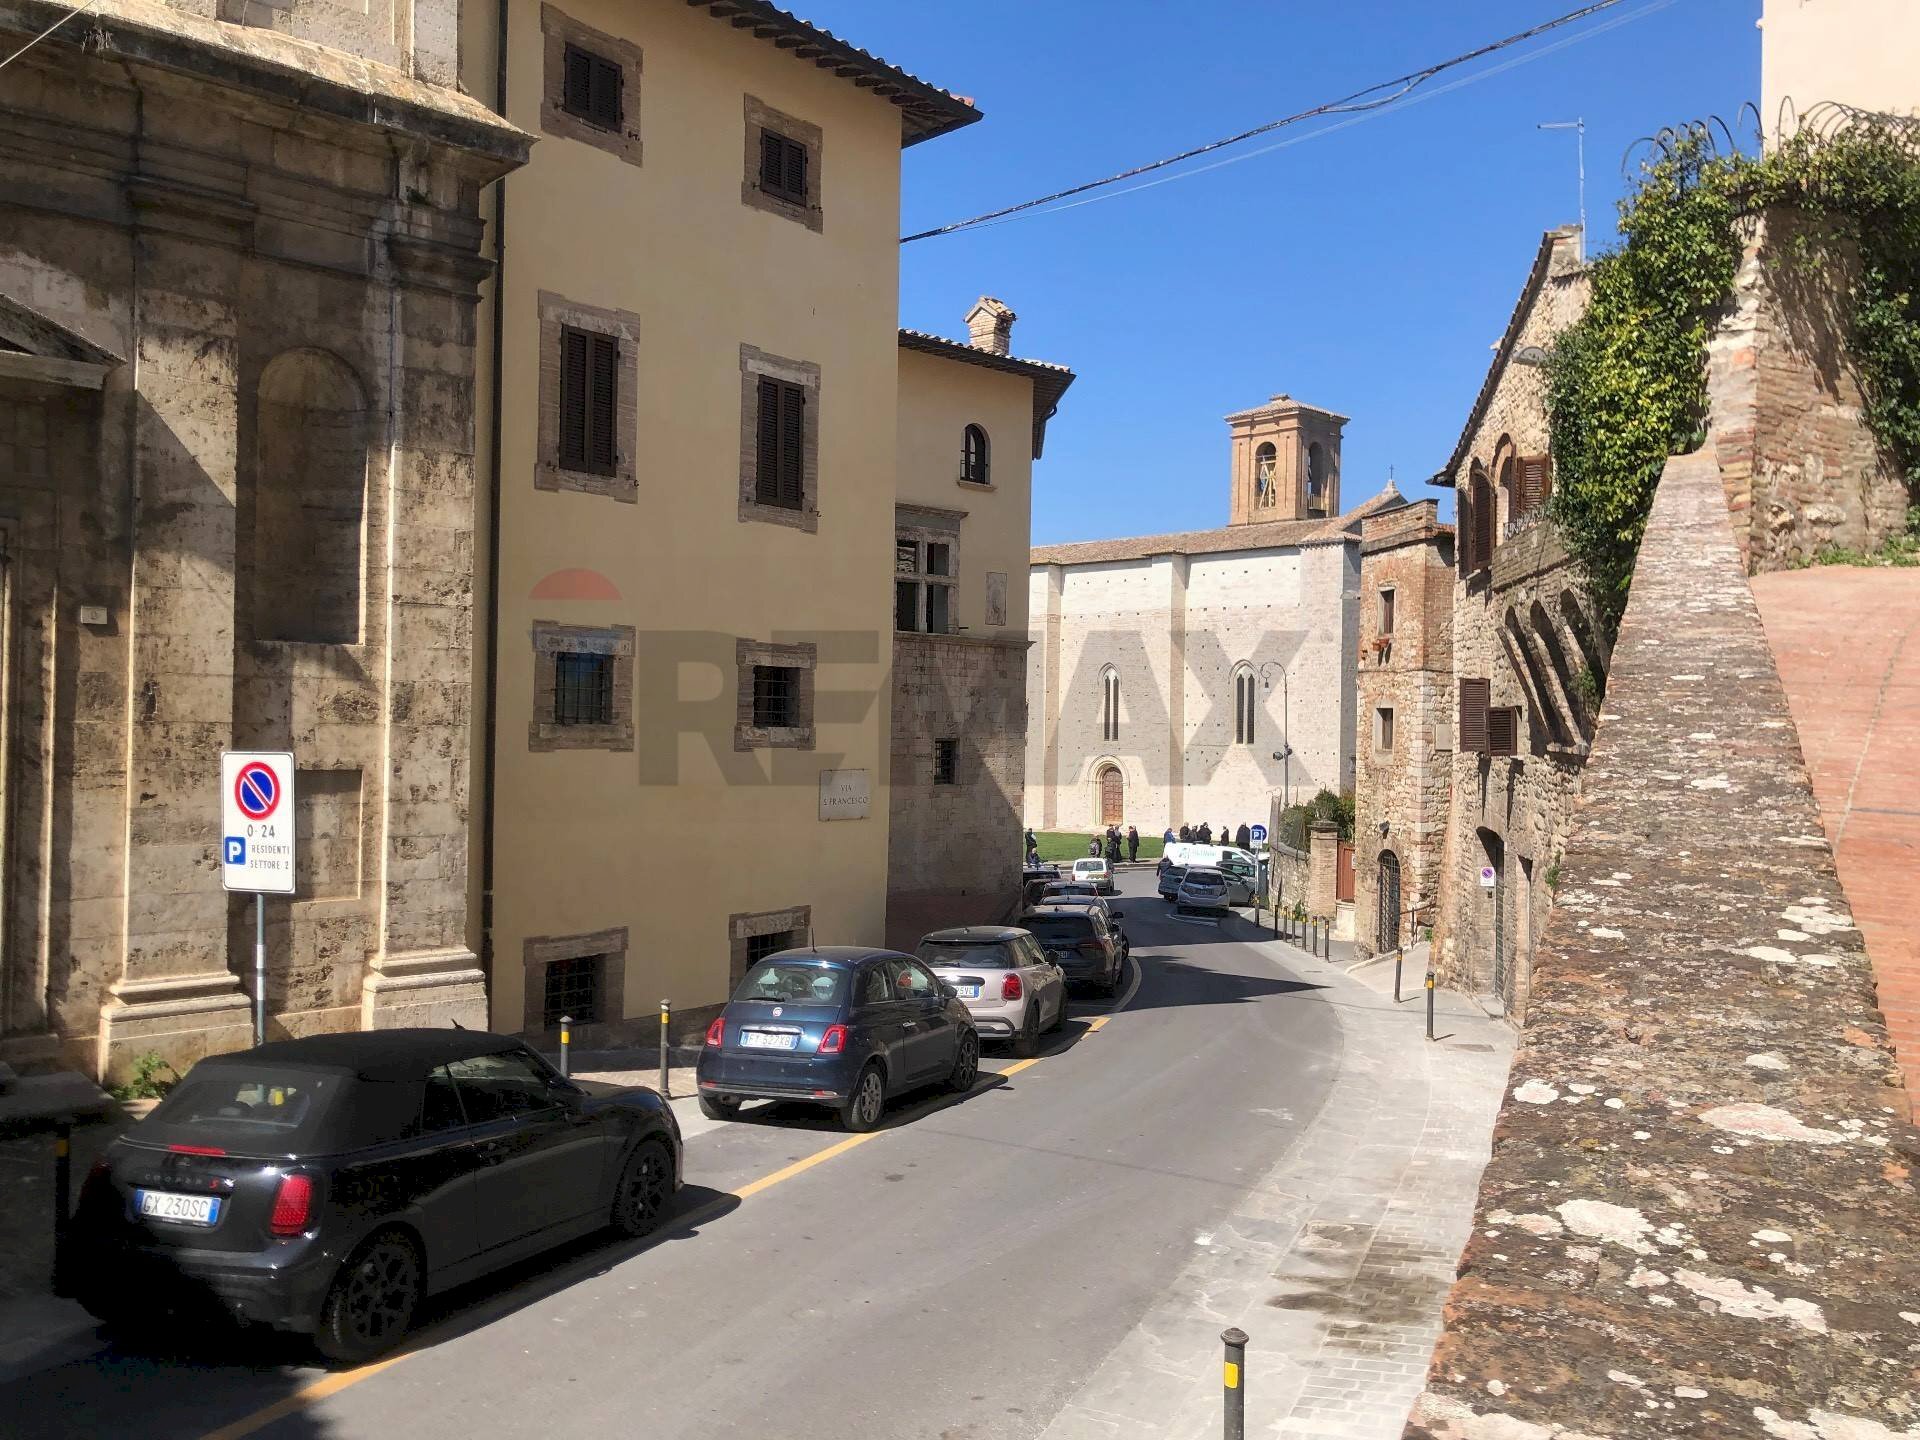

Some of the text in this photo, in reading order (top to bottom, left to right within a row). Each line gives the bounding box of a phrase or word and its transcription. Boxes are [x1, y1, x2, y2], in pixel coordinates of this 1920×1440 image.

[840, 784, 856, 792] VIA
[251, 844, 290, 855] RESIDENTI
[250, 860, 280, 870] SETTORE
[164, 1197, 208, 1218] 230SC
